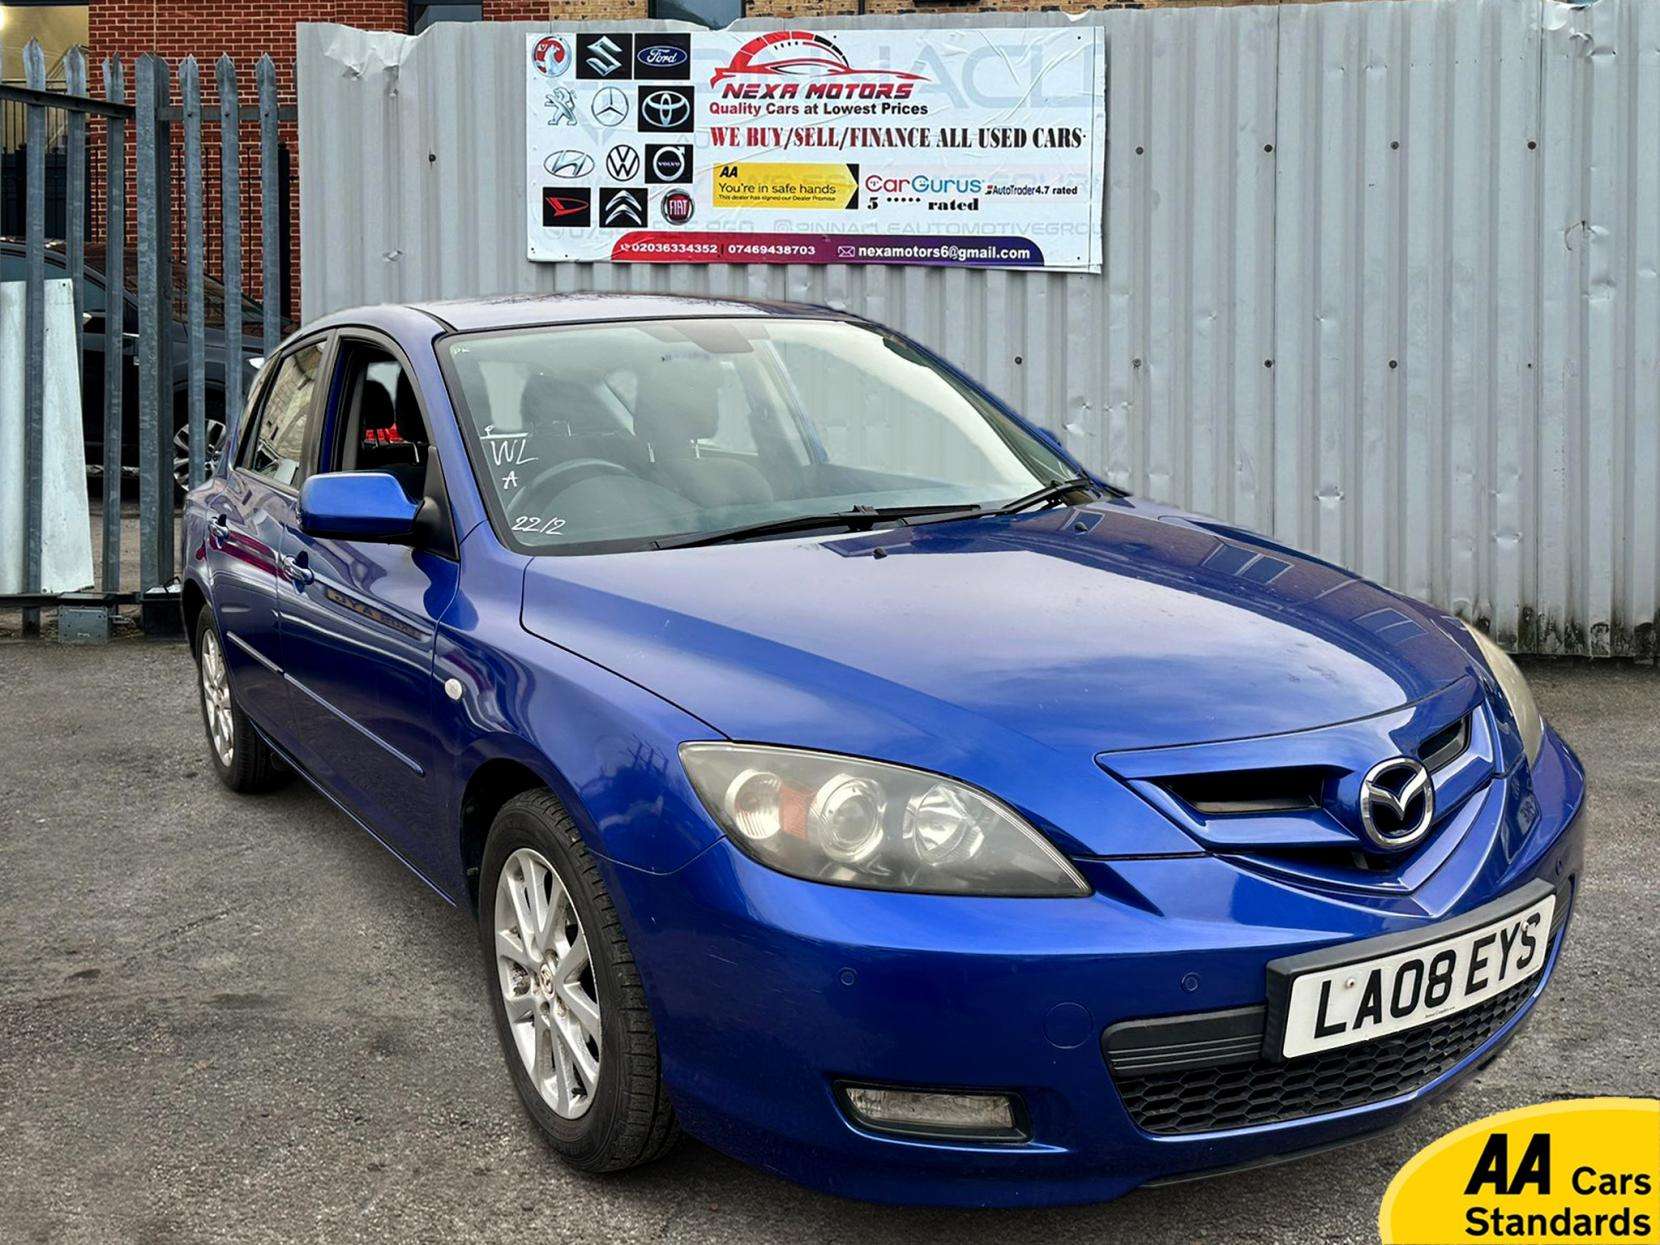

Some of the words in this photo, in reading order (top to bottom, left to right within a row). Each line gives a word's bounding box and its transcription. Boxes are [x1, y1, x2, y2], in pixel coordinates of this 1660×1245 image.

[646, 49, 677, 64] Ford
[721, 83, 798, 99] NEXA
[804, 83, 914, 99] MOTORS
[709, 102, 761, 117] Quality
[766, 103, 800, 115] Cars
[804, 104, 819, 115] at
[824, 103, 877, 115] Lowest
[882, 103, 928, 115] Prices
[710, 127, 740, 147] WE
[936, 127, 972, 148] ALL
[978, 127, 1027, 148] USED
[1032, 127, 1082, 148] CARS
[719, 166, 738, 177] AA
[718, 183, 755, 193] You're
[758, 183, 769, 193] in
[771, 183, 797, 193] safe
[799, 183, 836, 194] hands
[865, 174, 982, 193] CarGurus
[1052, 186, 1078, 195] rated
[669, 200, 688, 215] FIAT
[867, 197, 878, 210] 5
[928, 198, 979, 211] rated
[632, 244, 718, 254] 02036334352
[728, 244, 816, 255] 07469438703
[858, 245, 1030, 261] nexamotors6@gmail.com
[502, 470, 518, 489] A
[511, 516, 566, 535] 22/2
[1314, 949, 1457, 1039] LA08
[1464, 911, 1541, 996] EYS
